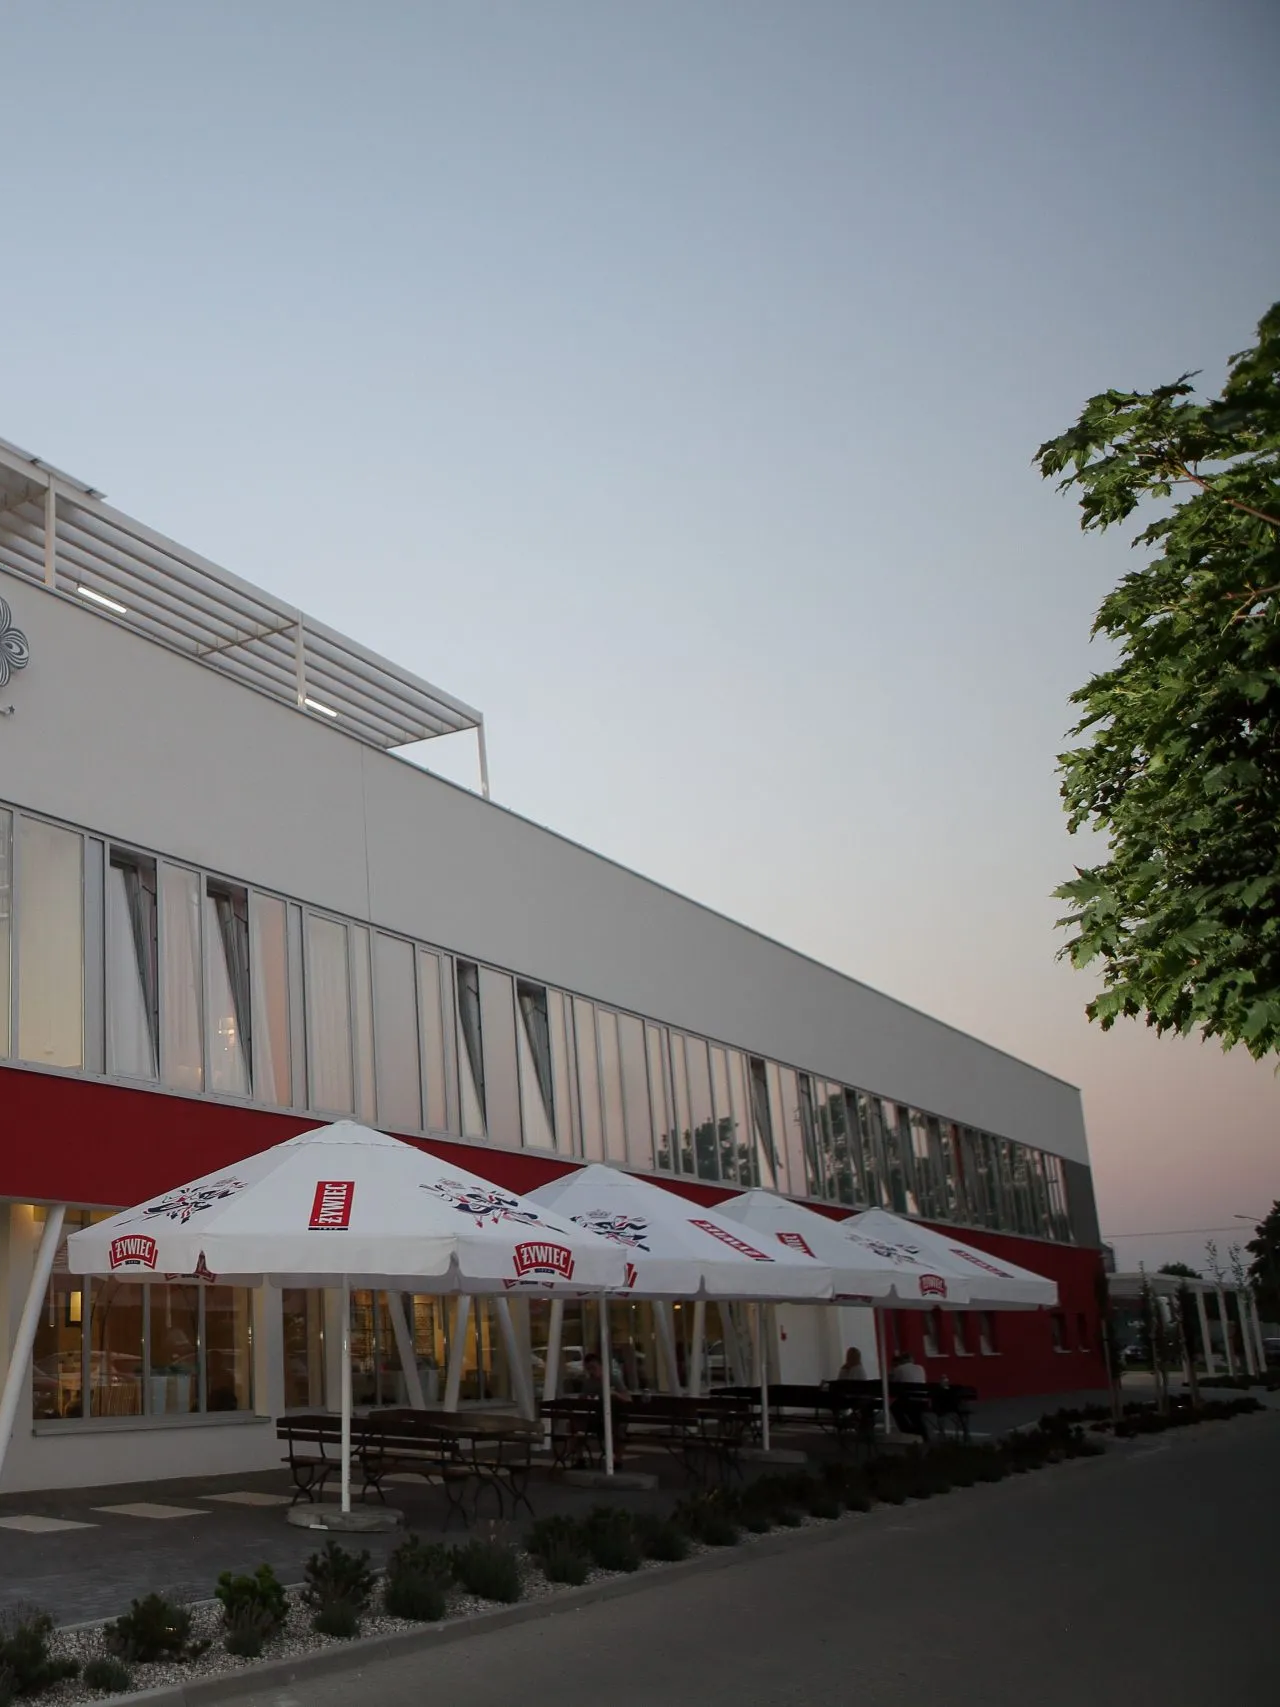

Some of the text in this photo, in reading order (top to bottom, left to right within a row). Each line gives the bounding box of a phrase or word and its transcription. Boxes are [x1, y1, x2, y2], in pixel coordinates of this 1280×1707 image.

[314, 1183, 348, 1224] ŻYWIEC
[115, 1238, 153, 1259] ŻYWIEC
[520, 1244, 568, 1268] ŻYWIEC
